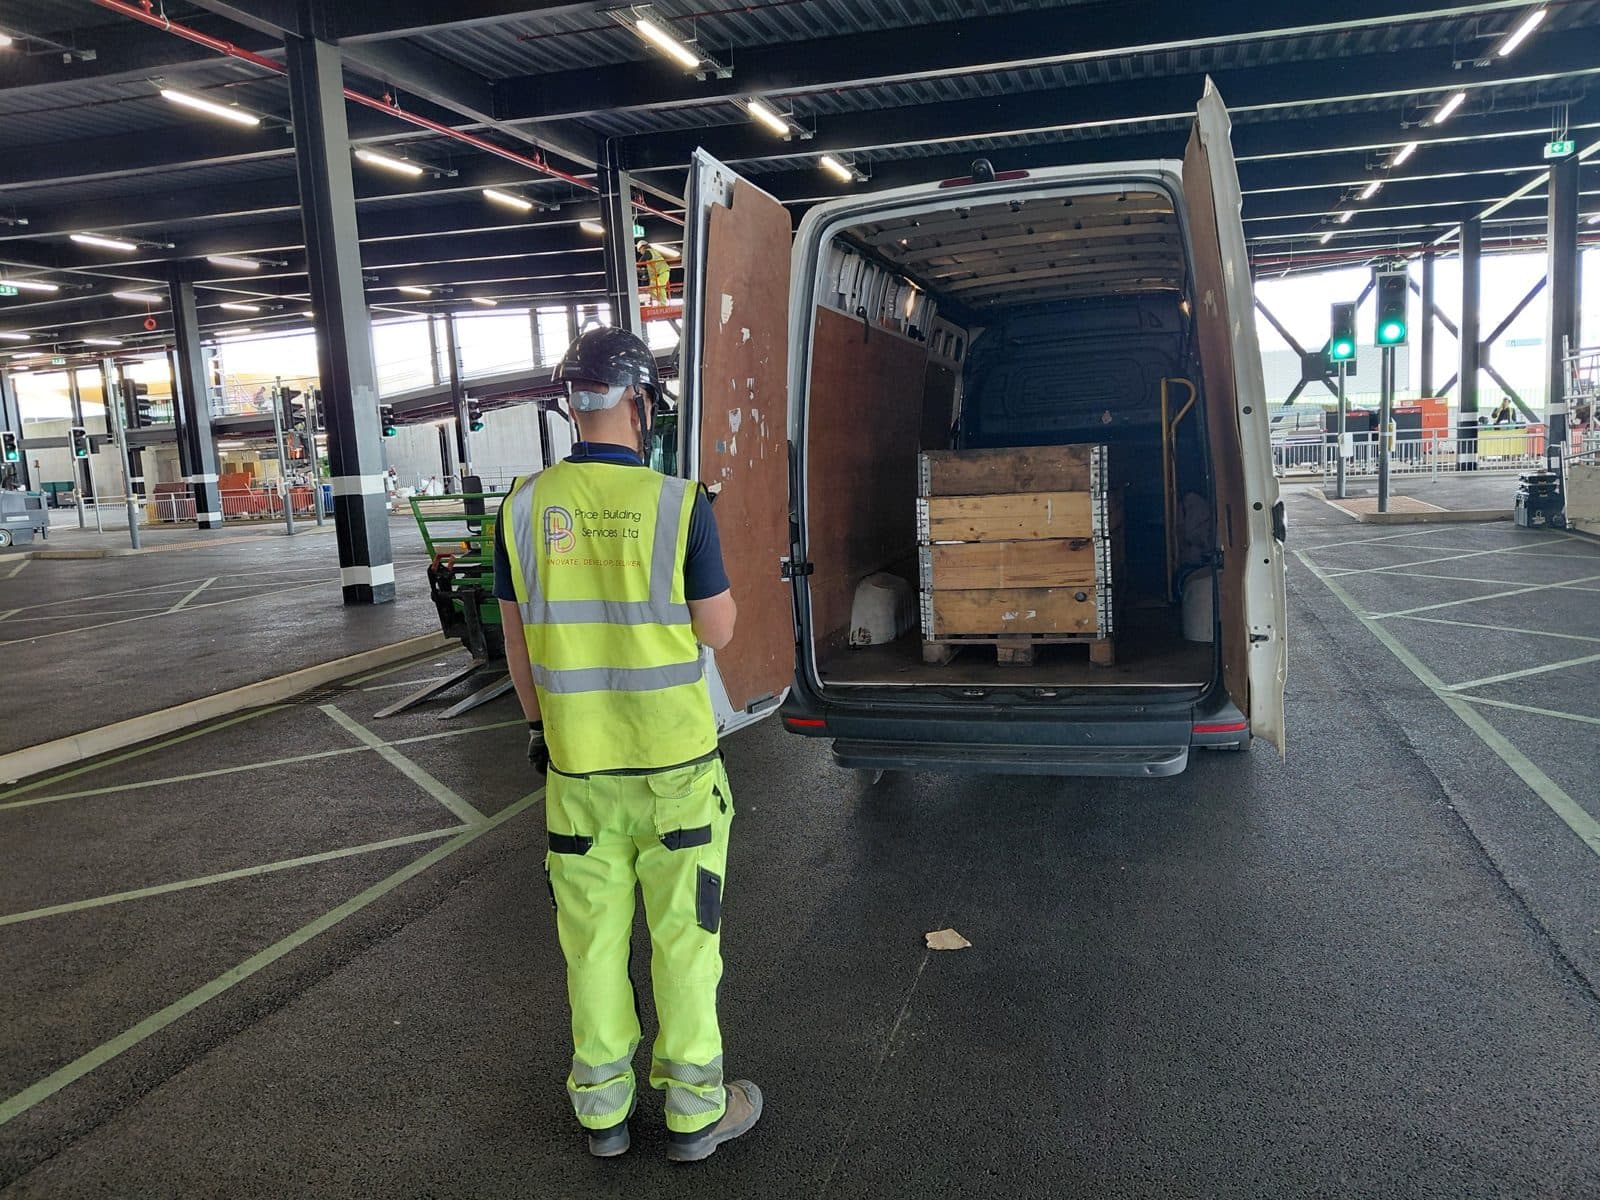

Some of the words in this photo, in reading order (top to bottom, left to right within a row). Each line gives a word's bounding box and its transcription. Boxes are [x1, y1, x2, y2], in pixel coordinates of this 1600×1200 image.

[574, 508, 599, 520] Price
[603, 509, 642, 523] Building
[581, 527, 618, 538] Services
[622, 527, 639, 539] Ltd
